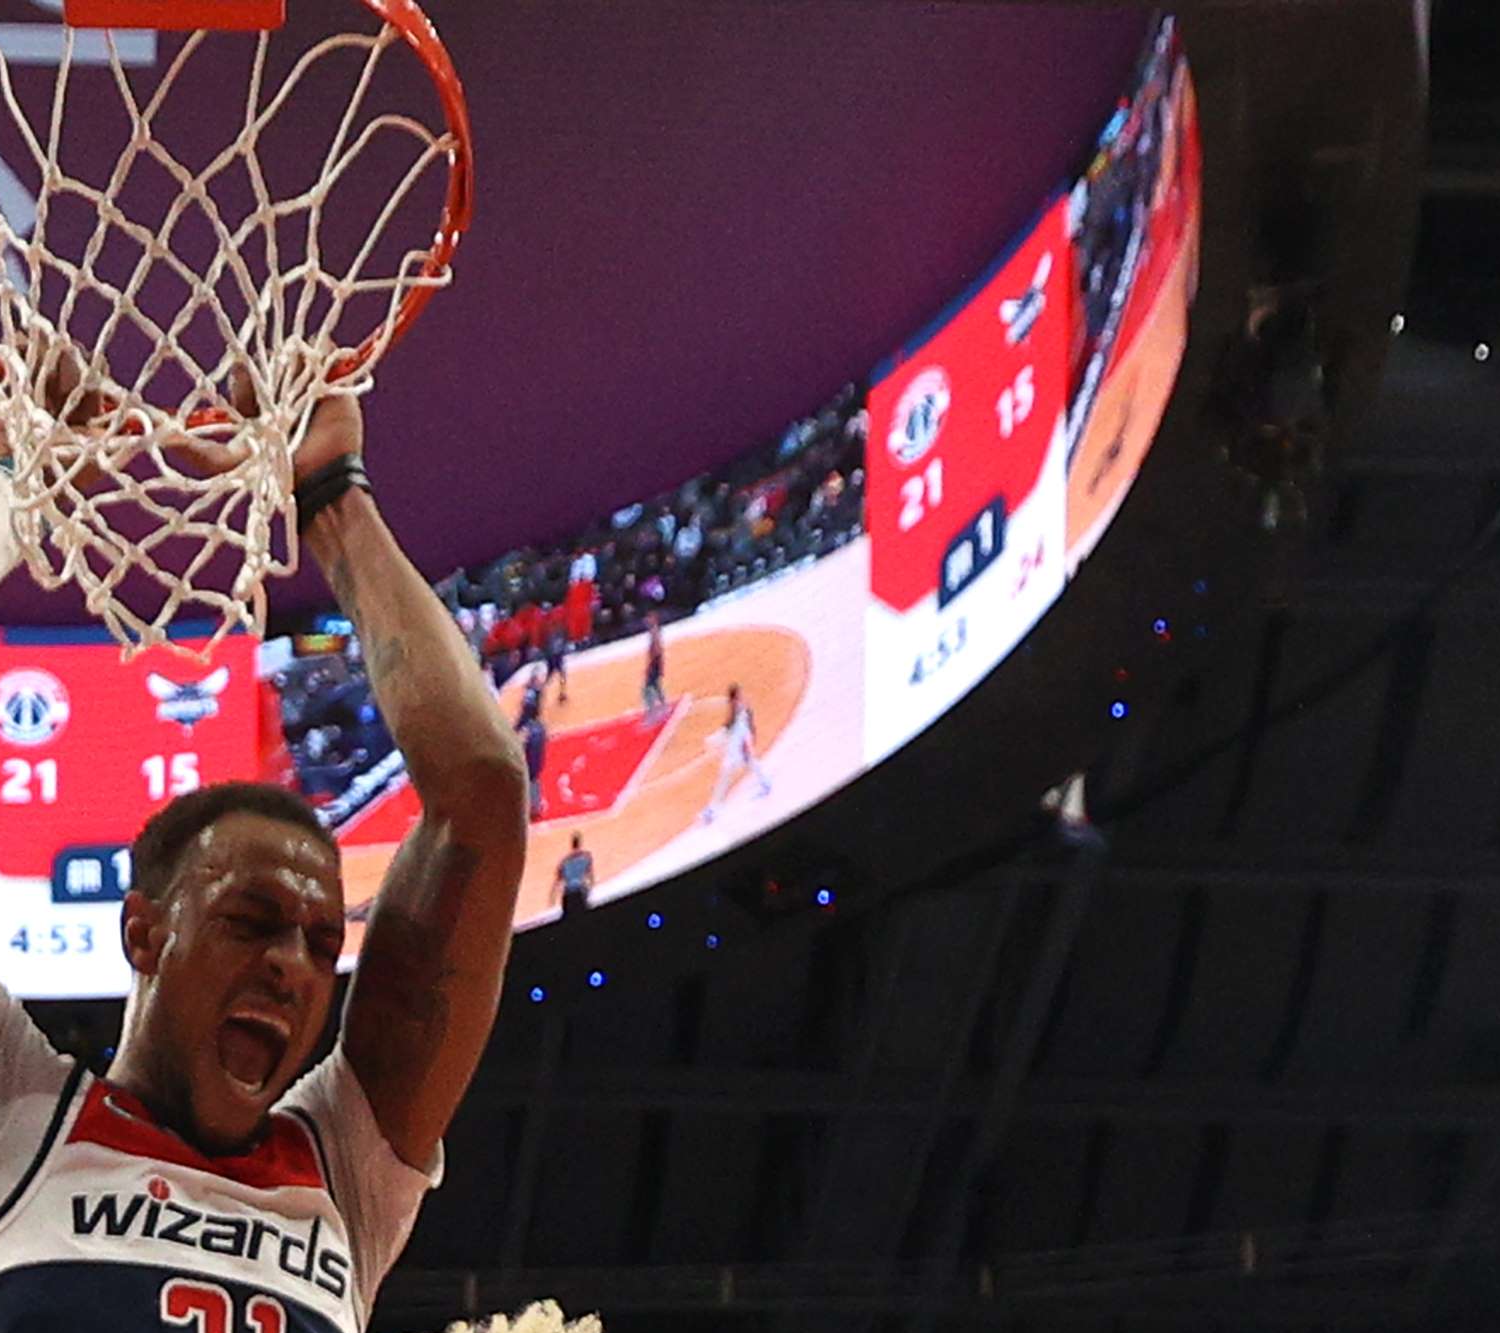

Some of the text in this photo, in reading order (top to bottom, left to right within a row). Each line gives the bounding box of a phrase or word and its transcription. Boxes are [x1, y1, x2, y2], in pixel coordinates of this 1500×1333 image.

[996, 364, 1035, 439] 15
[898, 457, 944, 532] 21
[908, 616, 968, 686] 4:53
[0, 758, 58, 804] 21
[141, 752, 200, 801] 15
[8, 924, 95, 954] 4:53
[70, 1176, 350, 1300] wizards
